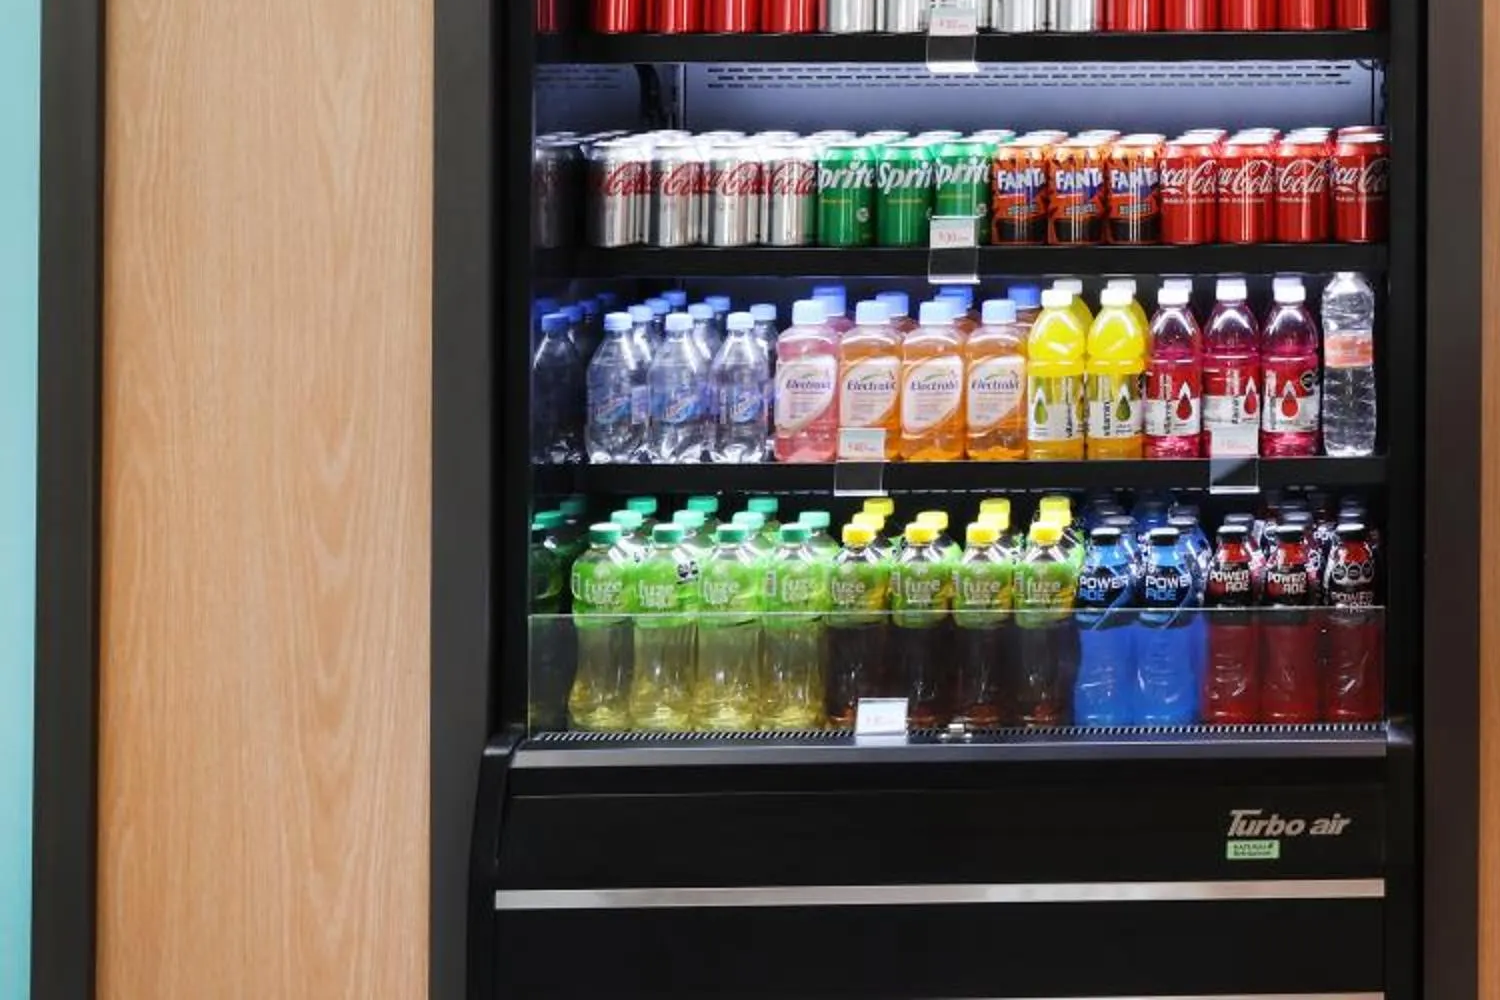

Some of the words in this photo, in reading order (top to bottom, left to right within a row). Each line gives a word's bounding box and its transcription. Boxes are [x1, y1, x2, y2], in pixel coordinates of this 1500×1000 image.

[878, 160, 933, 195] Sprit
[1210, 569, 1249, 583] POWER
[1268, 572, 1306, 584] POWER
[1227, 809, 1305, 837] Turbo
[1309, 812, 1352, 836] air
